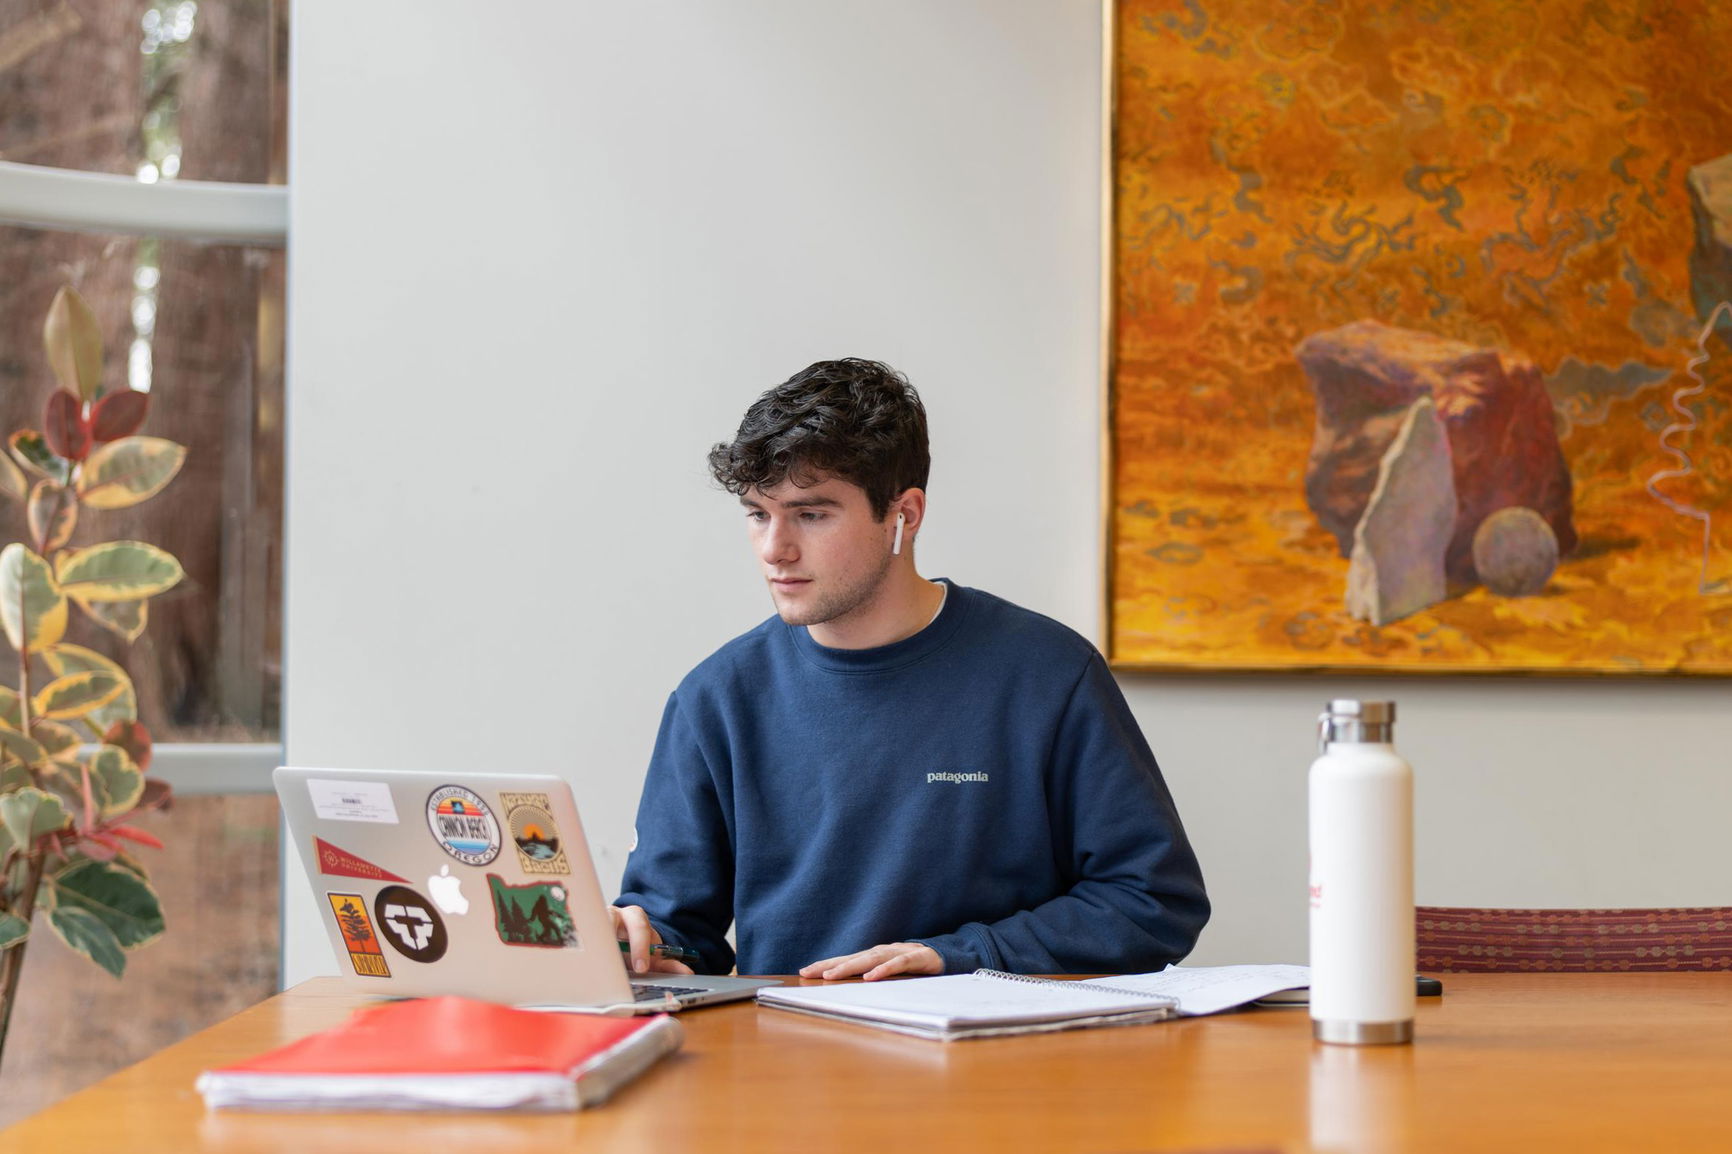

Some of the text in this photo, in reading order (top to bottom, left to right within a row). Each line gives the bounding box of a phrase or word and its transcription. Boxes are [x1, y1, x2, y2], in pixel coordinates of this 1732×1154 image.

[927, 771, 989, 784] patagonia
[438, 816, 491, 840] CANNON BEACH
[442, 841, 498, 864] OREGON
